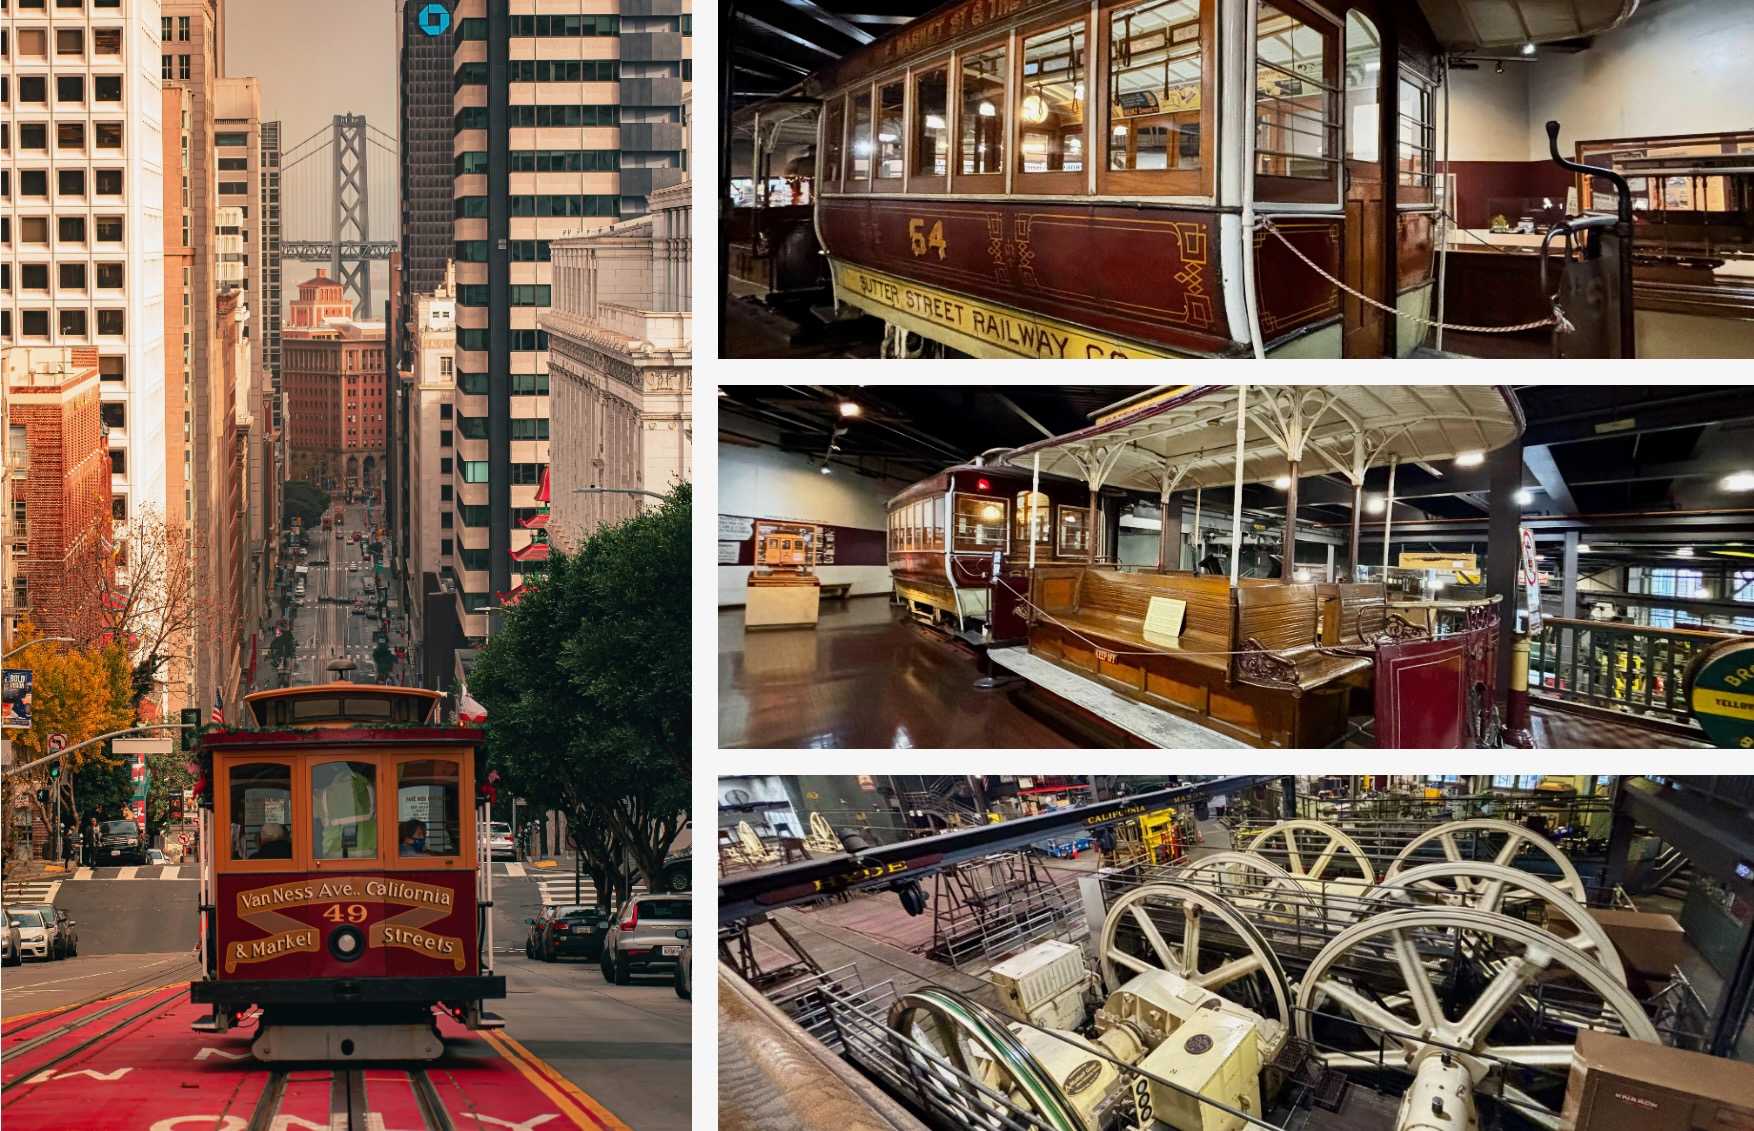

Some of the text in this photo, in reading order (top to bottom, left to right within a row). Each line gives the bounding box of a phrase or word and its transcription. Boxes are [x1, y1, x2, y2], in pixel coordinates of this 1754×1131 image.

[859, 275, 899, 305] SUTTER
[905, 290, 963, 327] STREET
[973, 310, 1069, 356] RAILWAY
[1724, 665, 1754, 688] BR
[1087, 805, 1146, 825] CALIFONIA
[241, 892, 271, 908] Van
[272, 885, 313, 902] Ness
[366, 880, 451, 905] California
[323, 904, 368, 923] 49
[236, 931, 312, 959] & Market
[384, 927, 454, 953] Streets
